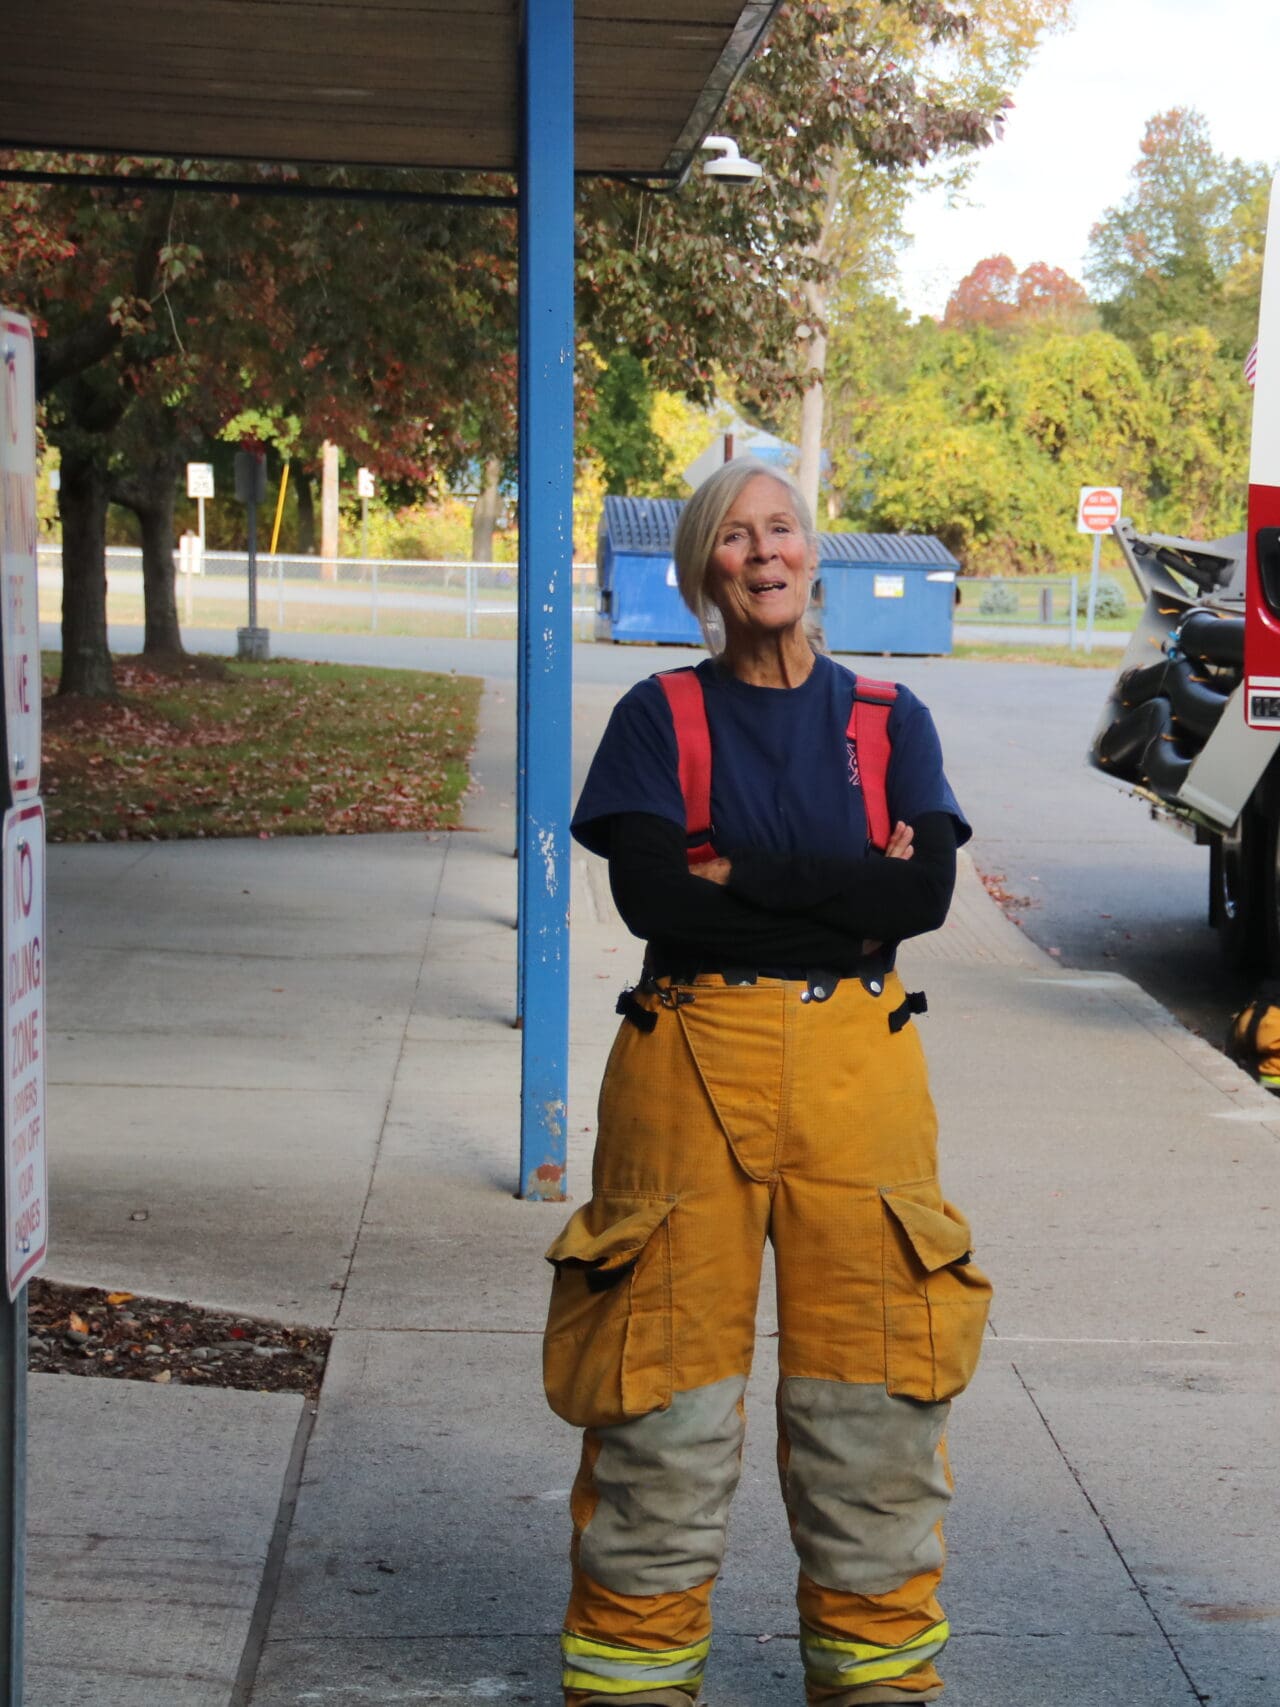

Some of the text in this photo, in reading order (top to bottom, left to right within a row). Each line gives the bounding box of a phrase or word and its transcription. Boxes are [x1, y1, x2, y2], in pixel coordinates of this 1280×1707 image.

[13, 842, 33, 923] NO
[9, 937, 41, 1006] IDLING
[12, 1009, 39, 1078] ZONE
[28, 1114, 41, 1152] OFF
